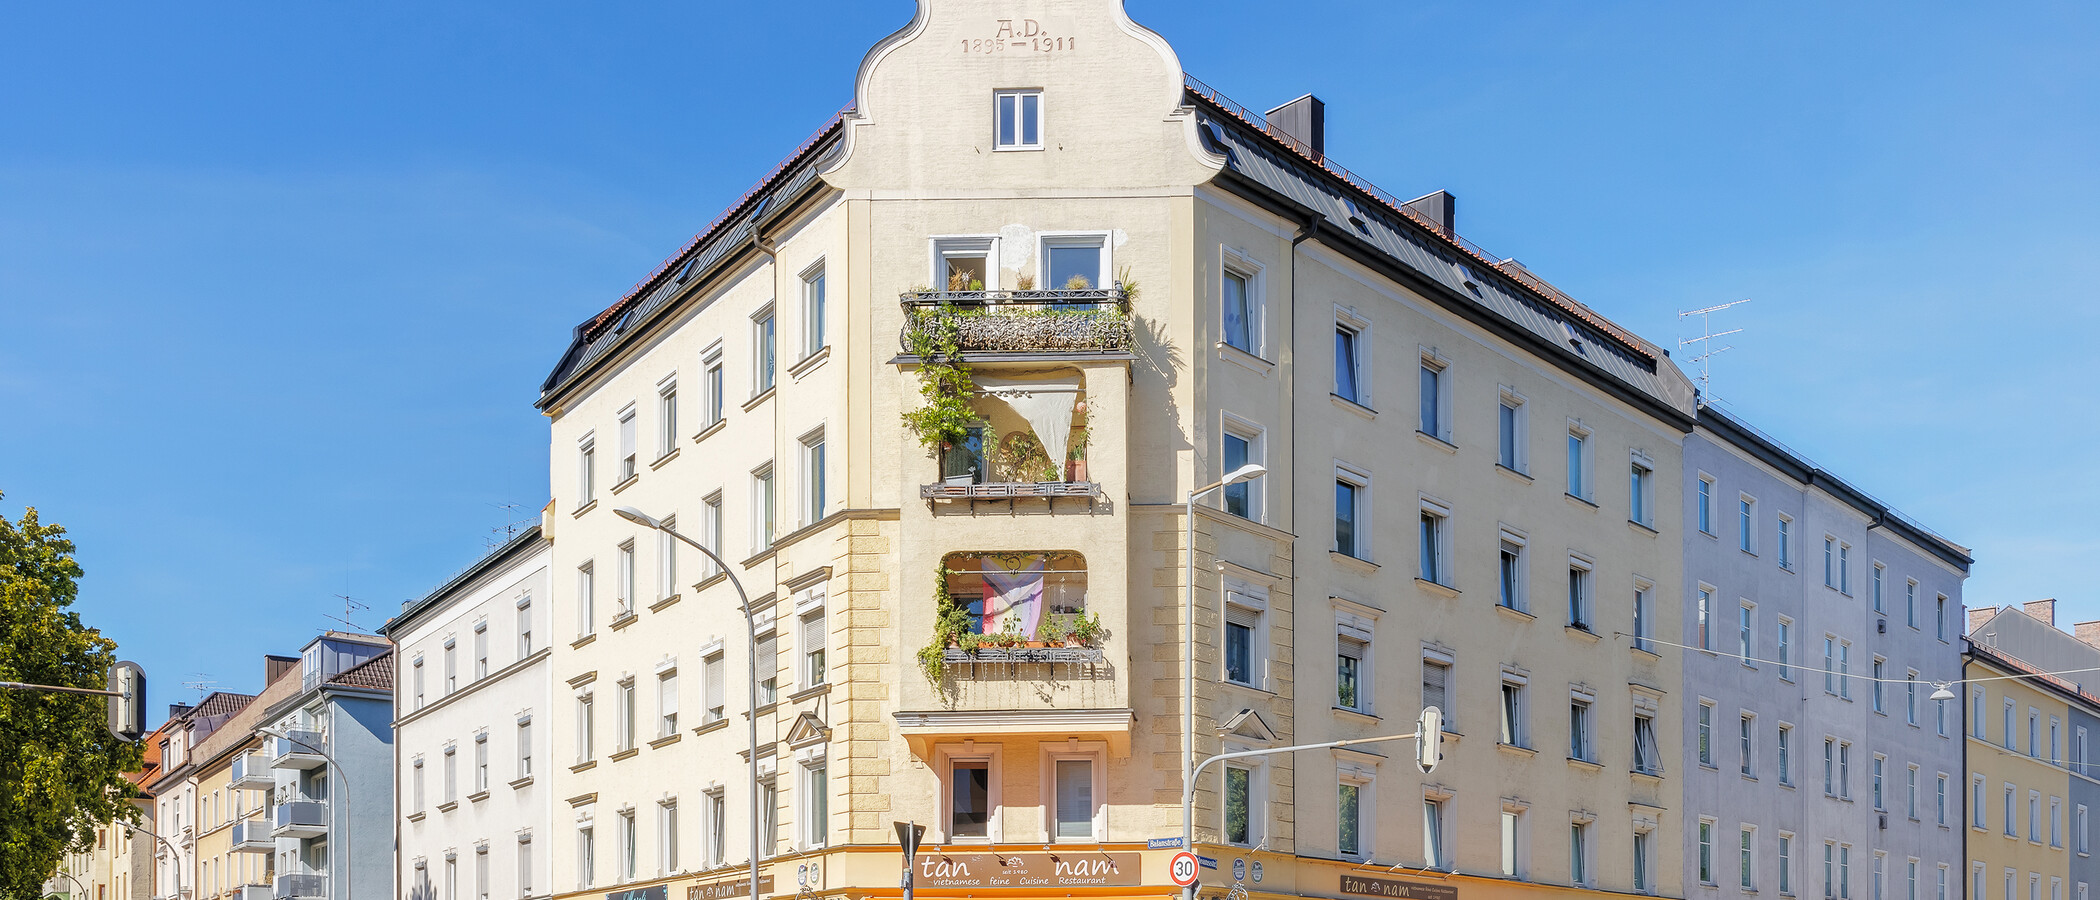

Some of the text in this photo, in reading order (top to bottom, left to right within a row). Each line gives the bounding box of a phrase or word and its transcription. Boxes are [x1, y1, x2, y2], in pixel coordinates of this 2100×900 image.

[996, 18, 1047, 38] A.D.
[921, 855, 1119, 878] tan nam
[1175, 861, 1192, 876] 30
[933, 876, 1106, 886] vietnamese feine Cuisine Restaurant
[1345, 876, 1367, 893] tan
[1383, 882, 1410, 897] nam
[689, 887, 704, 900] tan
[715, 884, 735, 898] nam
